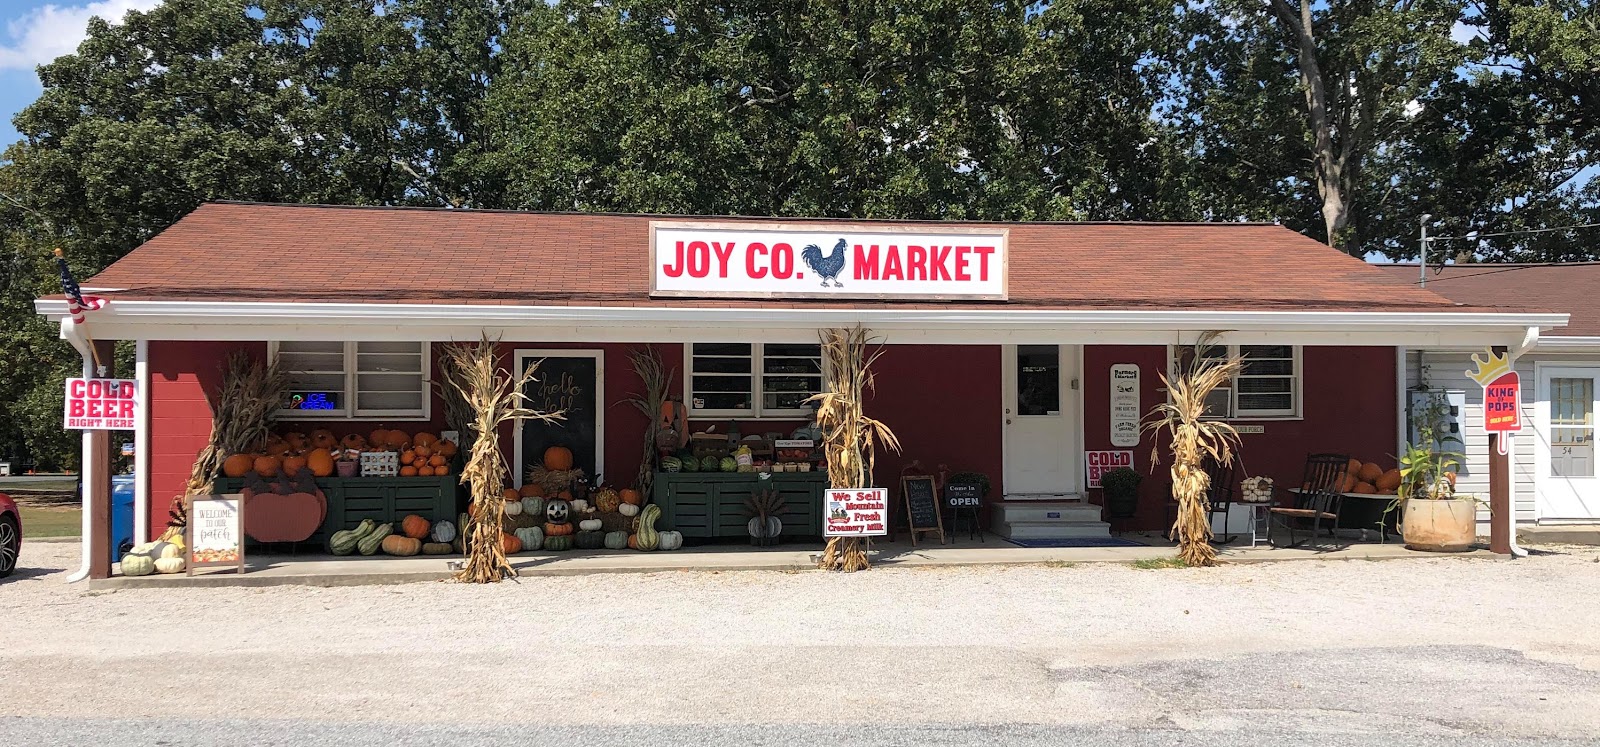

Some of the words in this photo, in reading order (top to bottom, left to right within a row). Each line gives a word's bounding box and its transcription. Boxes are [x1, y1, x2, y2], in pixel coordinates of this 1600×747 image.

[662, 241, 736, 278] JOY
[745, 242, 804, 280] CO.
[853, 244, 996, 282] MARKET
[70, 379, 135, 399] COLD
[537, 371, 583, 399] hello
[307, 393, 327, 402] ICE
[1488, 387, 1514, 398] KING
[69, 399, 135, 418] BEER
[300, 401, 335, 410] CREAM
[1488, 402, 1515, 412] POPS
[68, 418, 103, 427] RIGHT
[105, 419, 135, 428] HERE
[1562, 446, 1572, 455] 54
[1088, 452, 1131, 466] COLD
[832, 492, 851, 501] We
[856, 491, 881, 501] Sell
[845, 501, 884, 511] Mountain
[949, 497, 979, 506] OPEN
[199, 509, 233, 519] WELCOME
[854, 511, 881, 522] Fresh
[205, 519, 213, 528] TO
[214, 519, 227, 528] OUR
[828, 525, 865, 534] Creamery
[866, 523, 884, 531] Milk
[200, 527, 231, 543] patch
